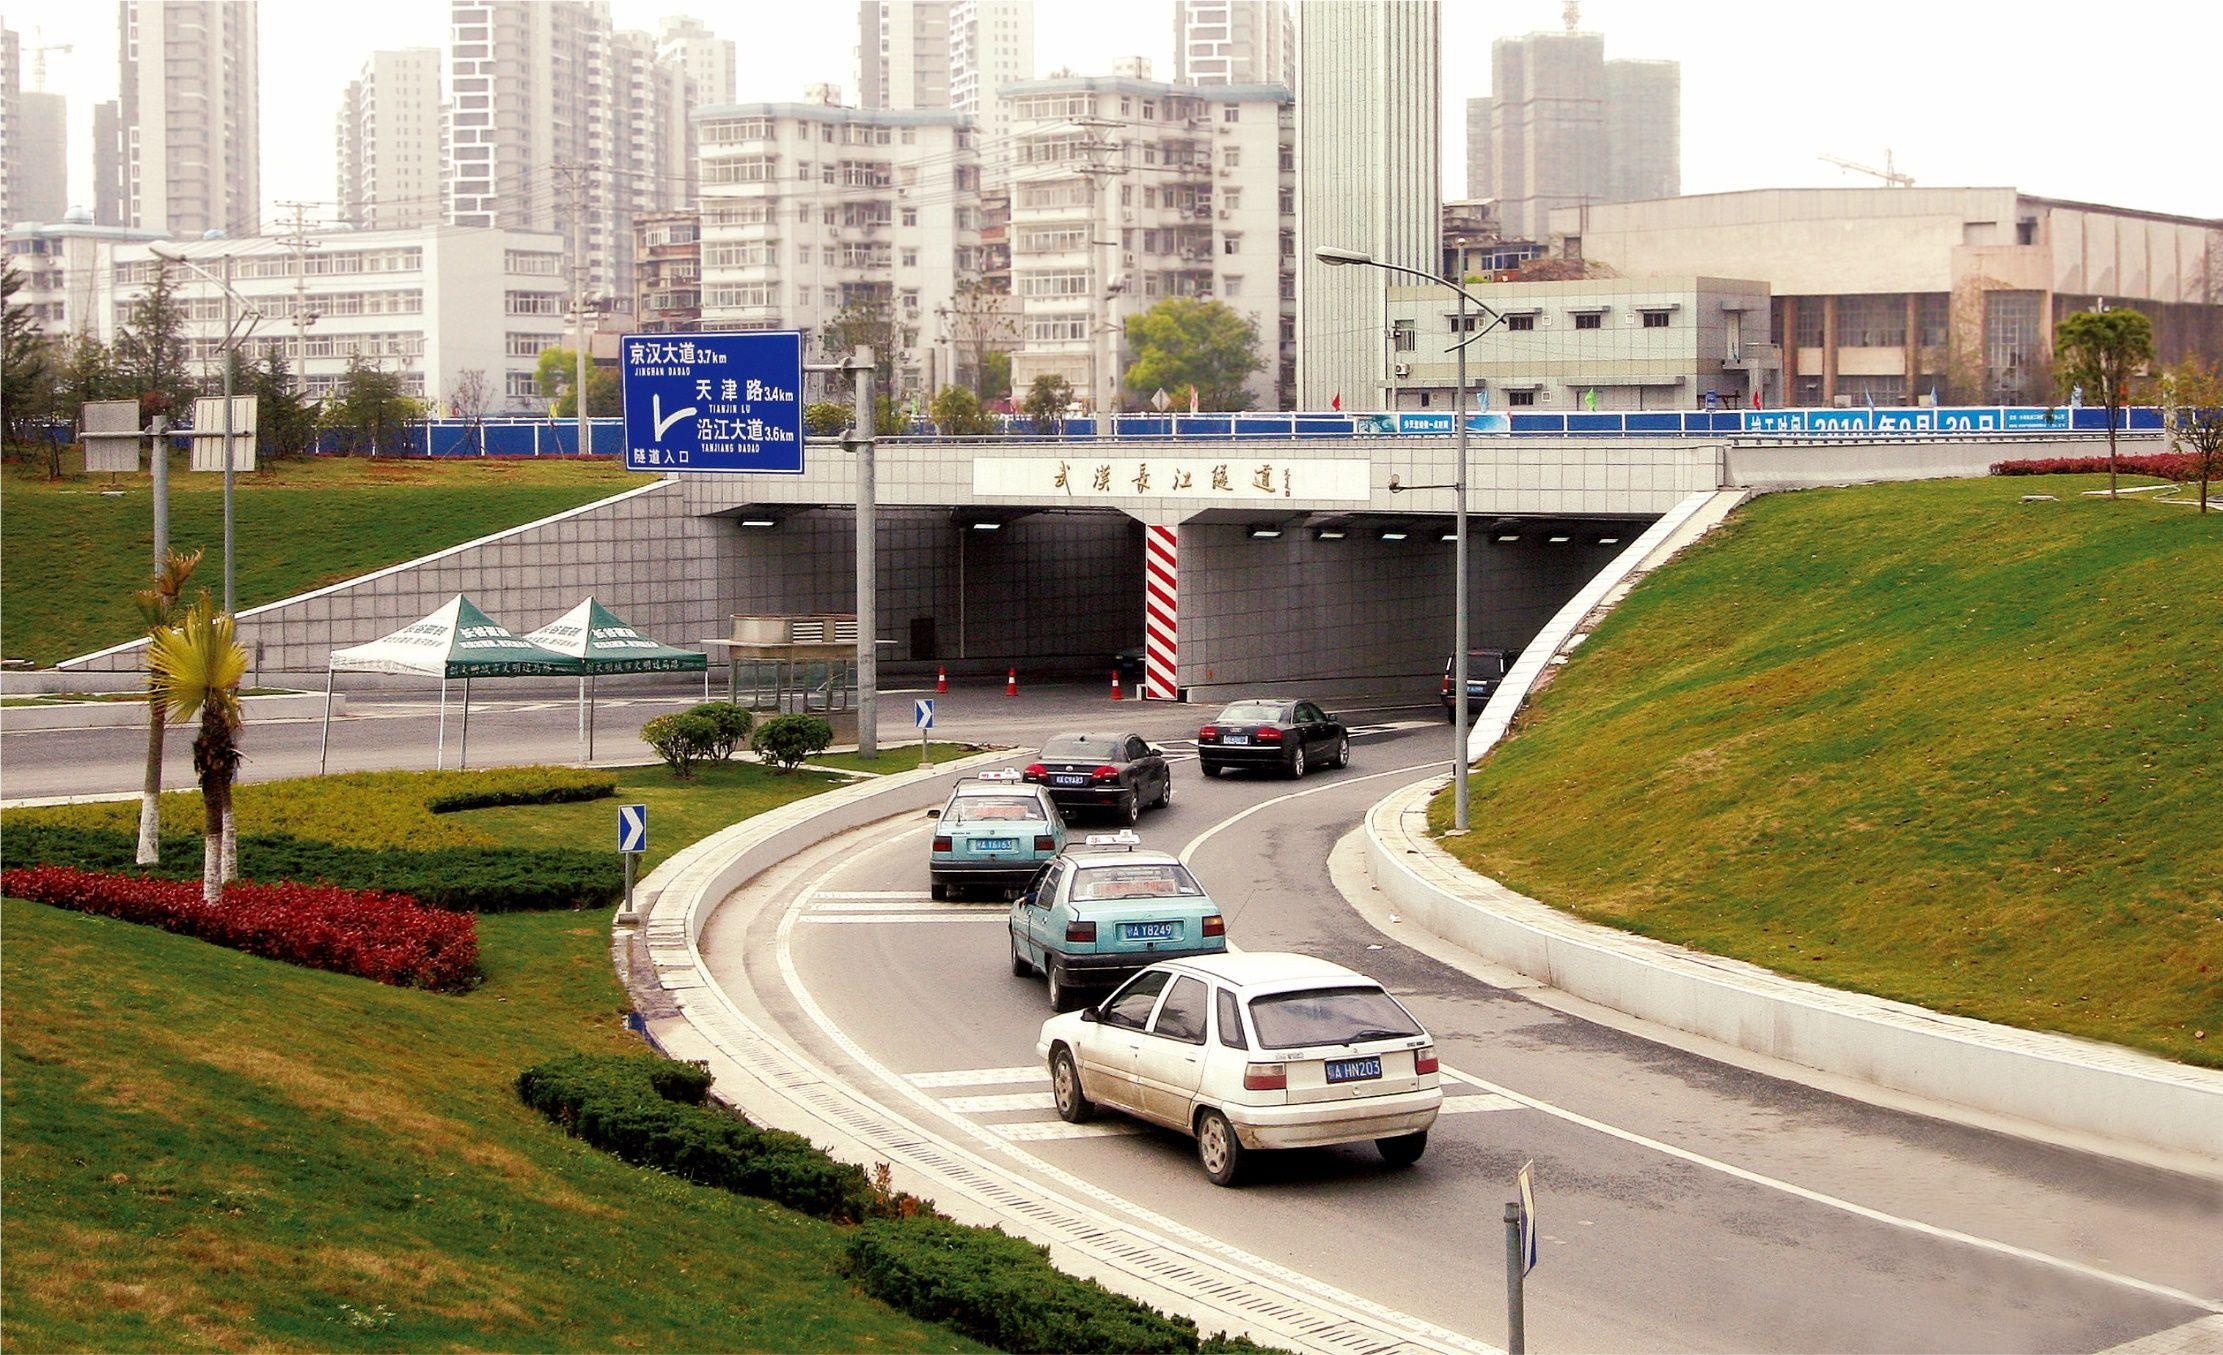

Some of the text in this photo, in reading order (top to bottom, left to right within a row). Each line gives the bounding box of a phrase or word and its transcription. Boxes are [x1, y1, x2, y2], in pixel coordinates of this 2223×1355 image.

[629, 342, 727, 365] 京汉大道 3.7km
[634, 366, 691, 377] JINGHAN DADAO
[696, 379, 794, 402] 天津路 3.4km
[709, 404, 751, 414] TIANJIN LU
[697, 418, 794, 442] 沿江大道 3.6km
[633, 448, 689, 465] 隧道入口
[701, 443, 760, 453] YANJIANG DADAO
[1141, 924, 1172, 936] Y8249
[1344, 1060, 1381, 1078] HN203
